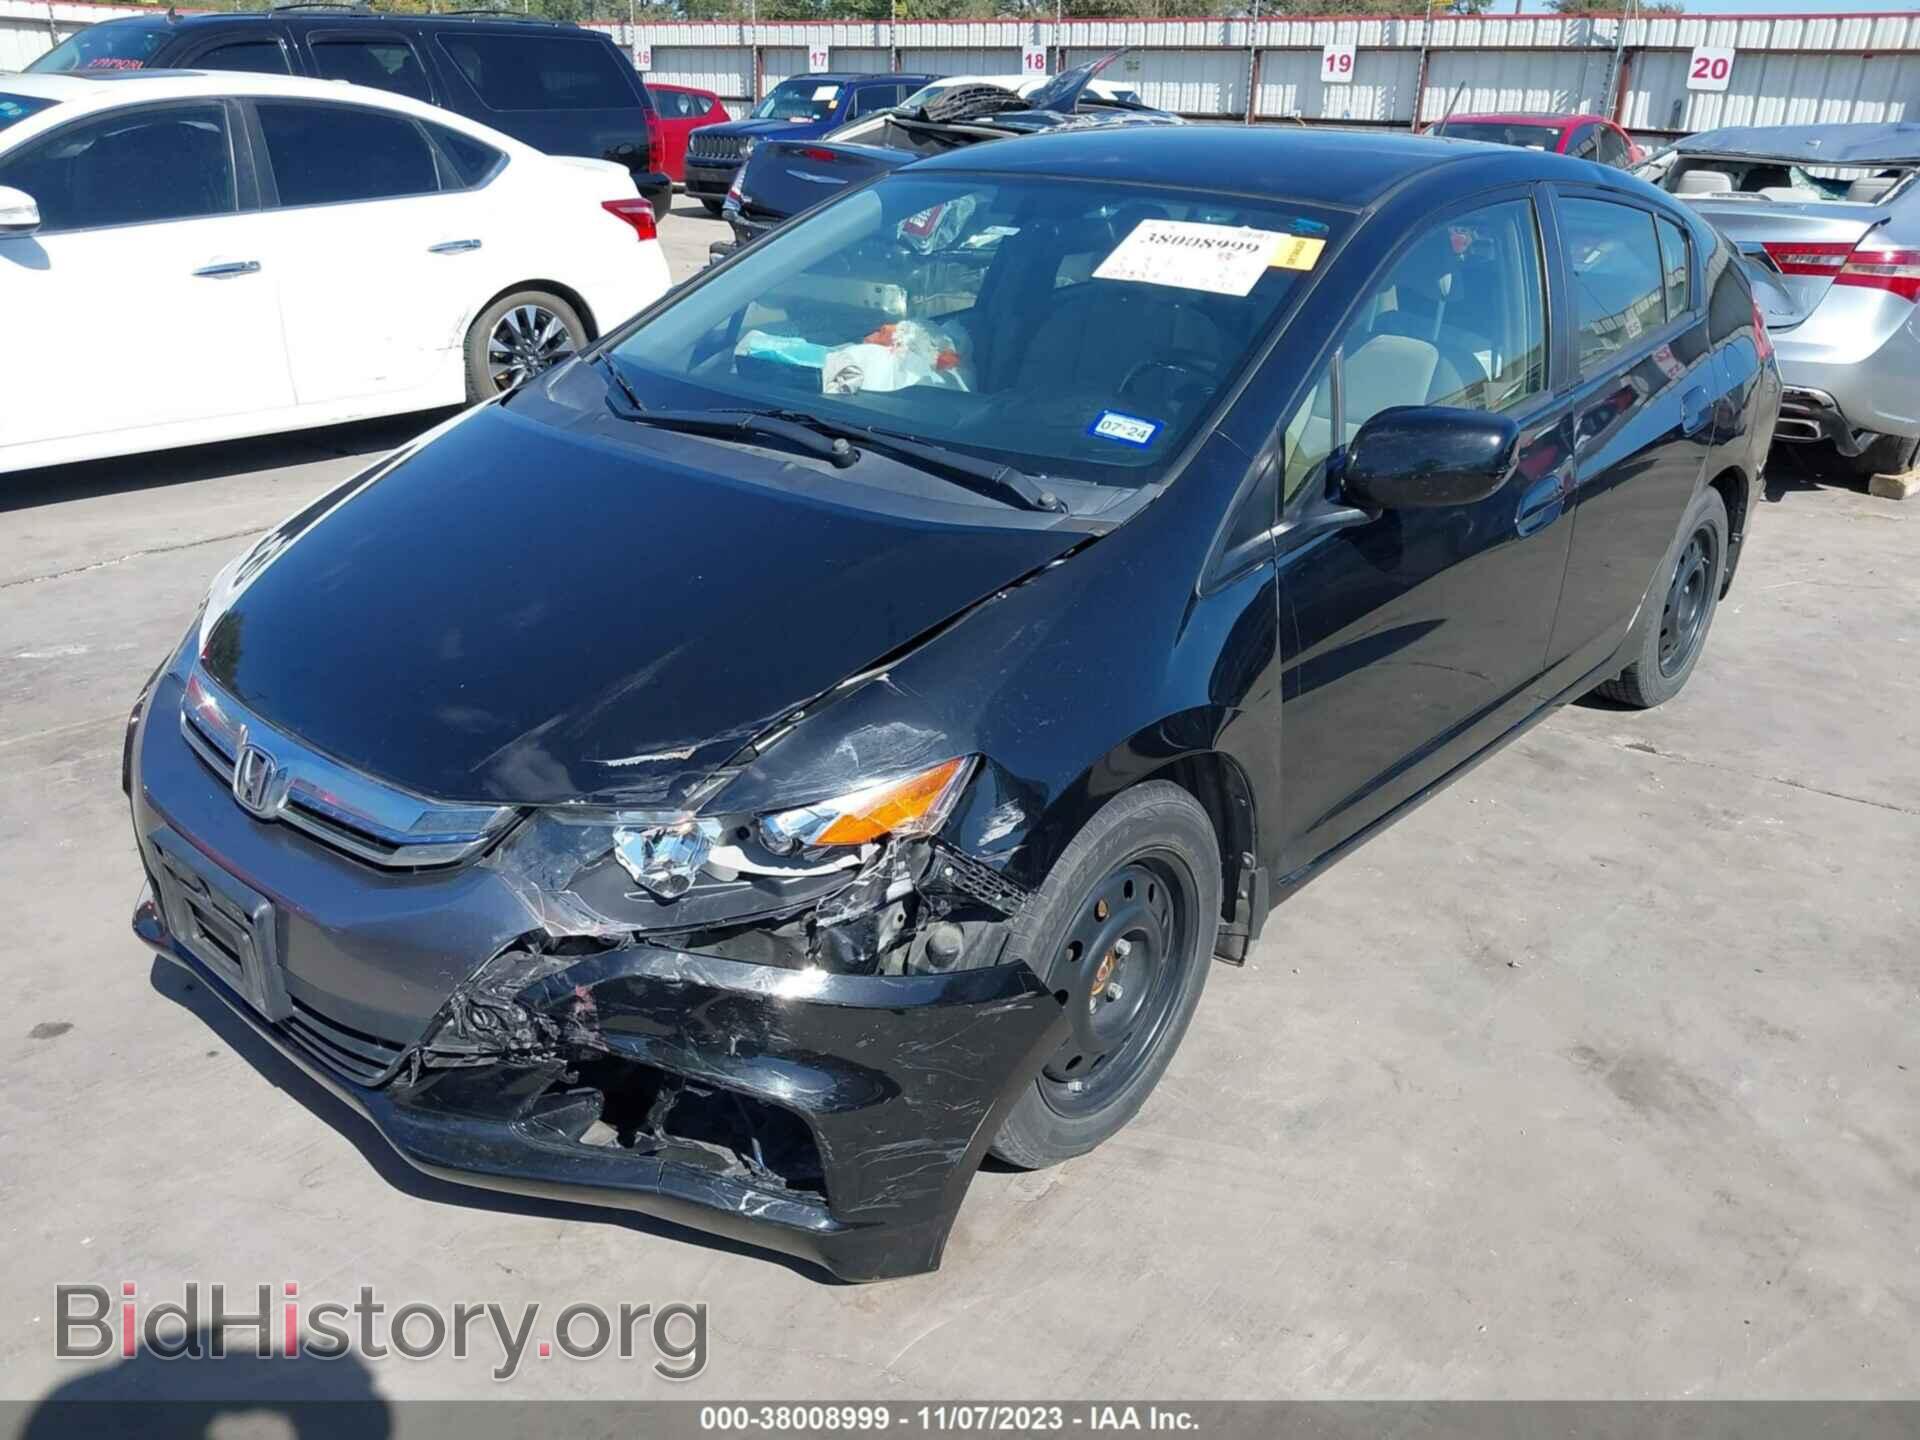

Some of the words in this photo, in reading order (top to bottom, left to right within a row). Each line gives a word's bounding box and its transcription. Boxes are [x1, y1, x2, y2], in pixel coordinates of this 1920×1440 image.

[638, 51, 650, 64] 16
[811, 52, 827, 66] 17
[1025, 53, 1044, 69] 18
[1326, 54, 1351, 72] 19
[1691, 57, 1729, 79] 20
